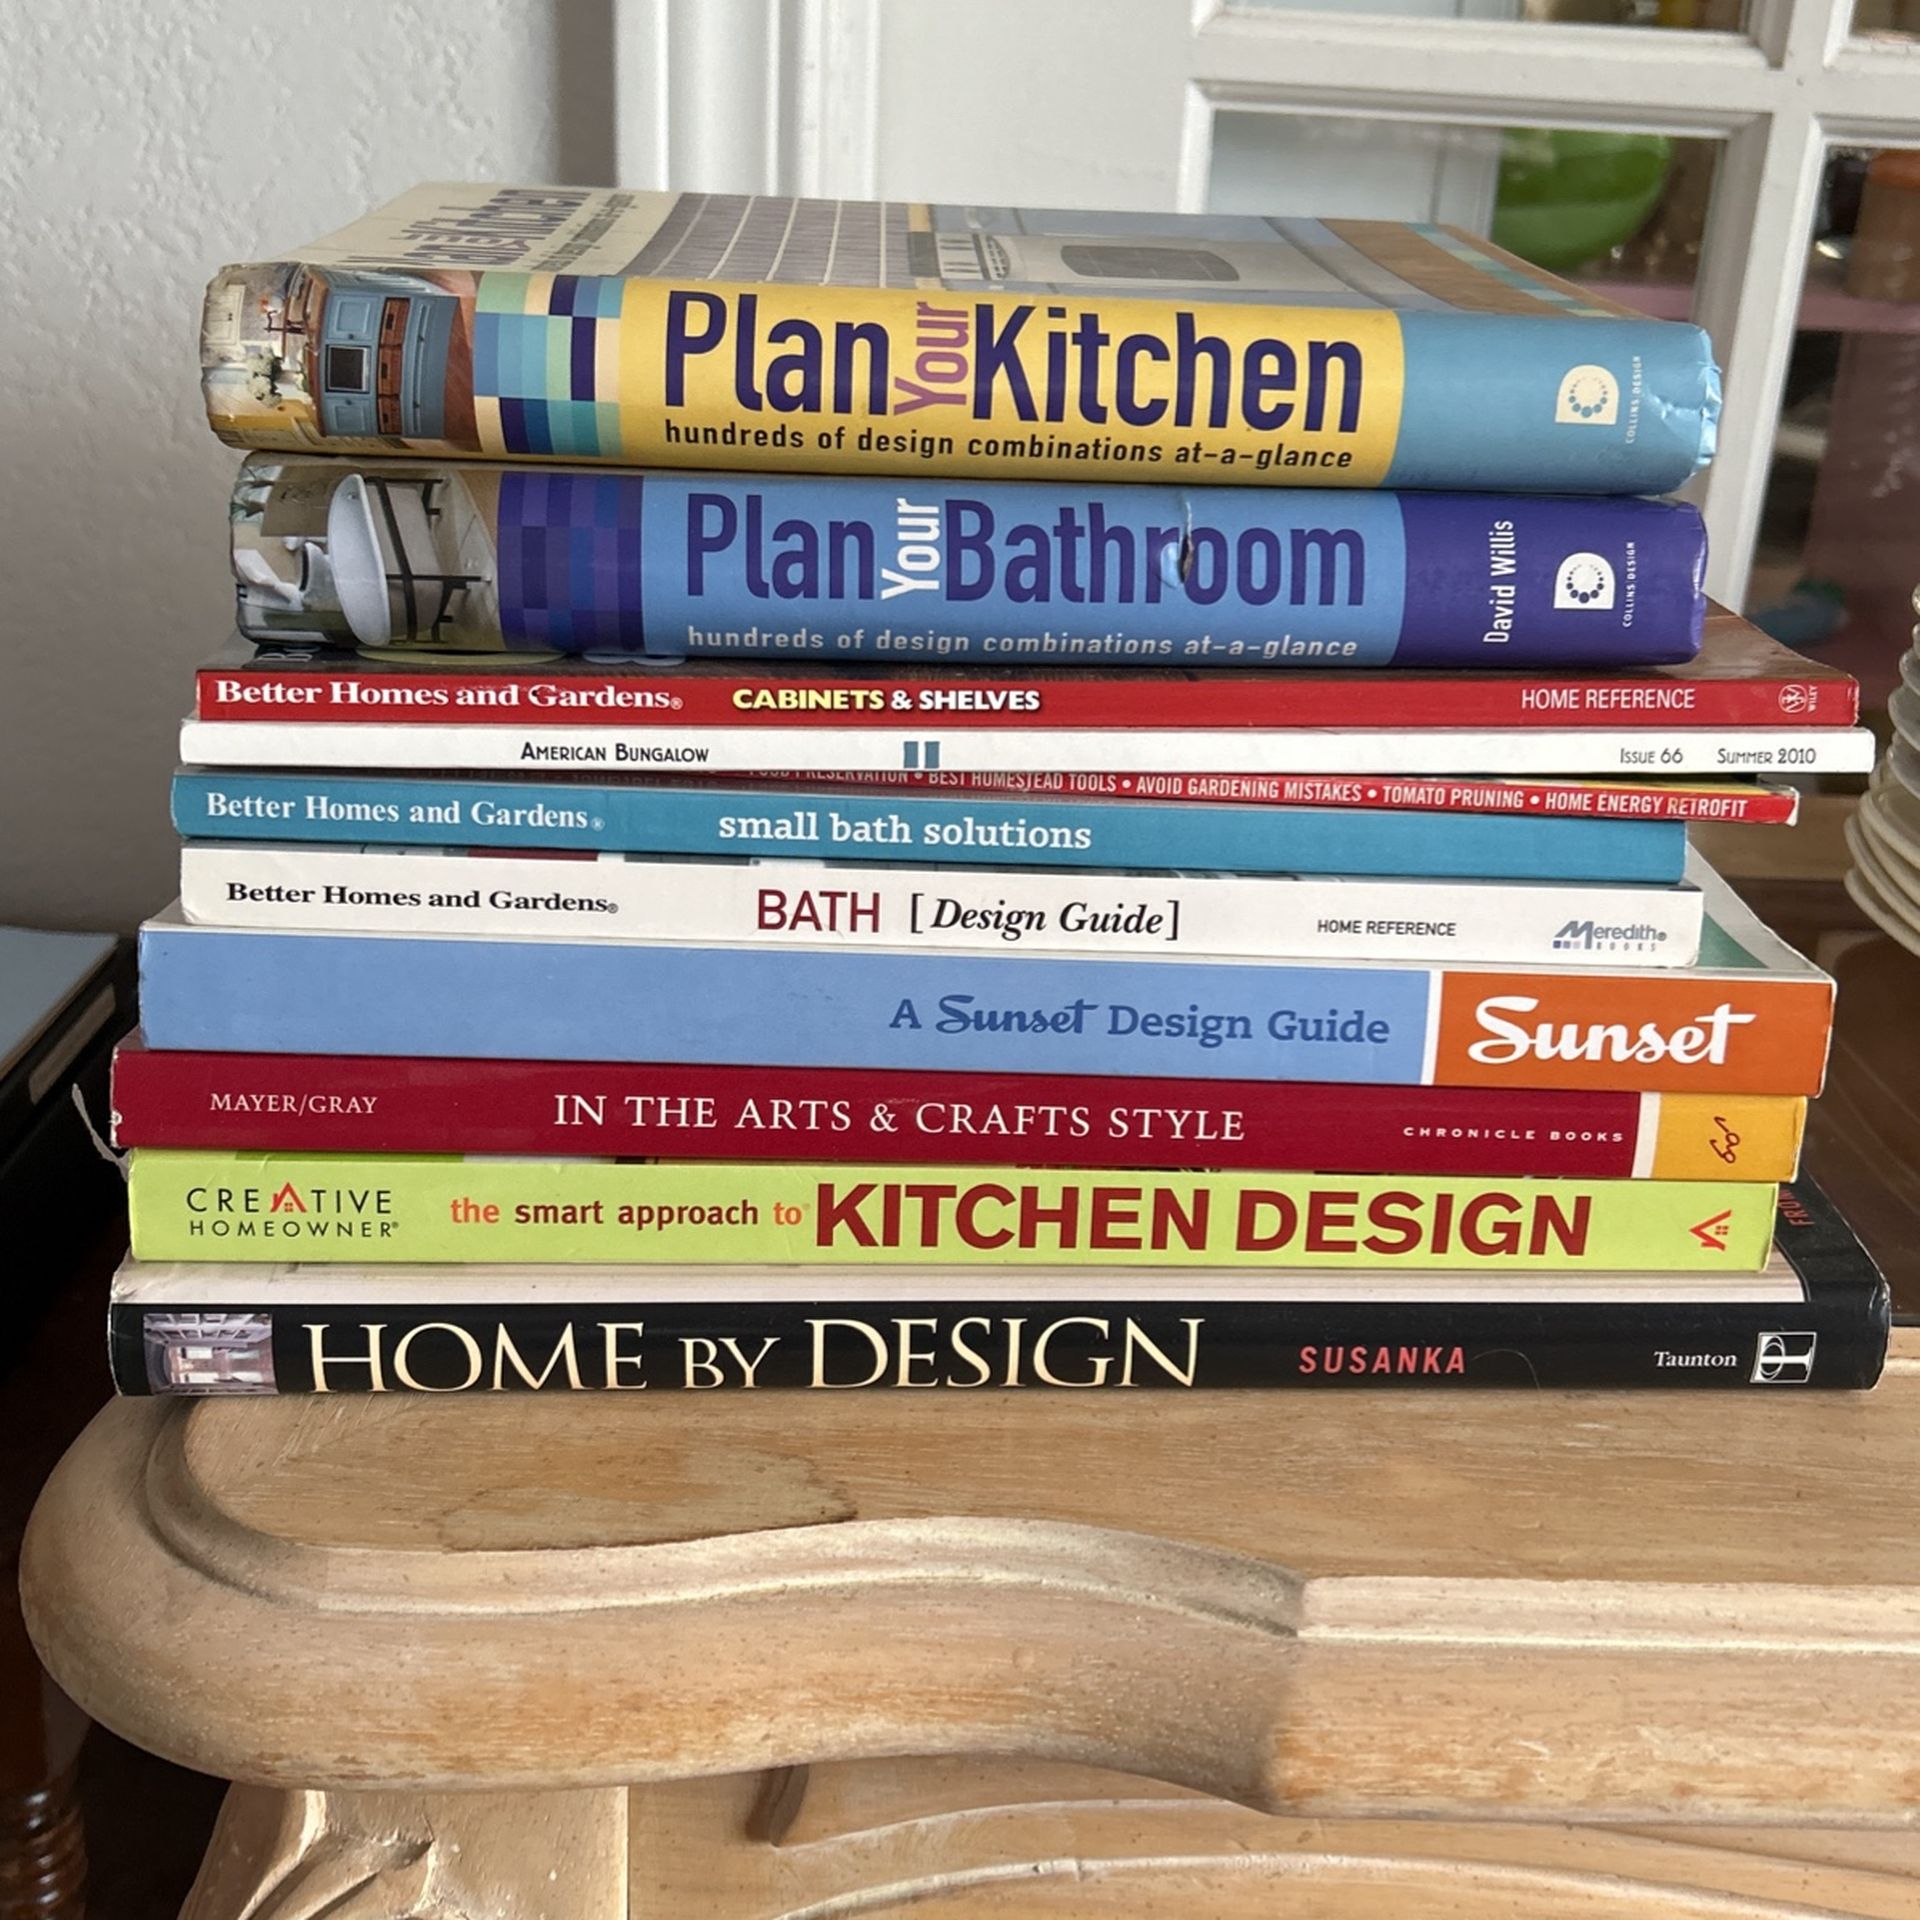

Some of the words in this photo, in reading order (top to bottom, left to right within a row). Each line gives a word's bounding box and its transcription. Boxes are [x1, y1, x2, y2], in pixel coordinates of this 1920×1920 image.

[664, 290, 889, 416] Plan
[893, 301, 969, 416] Your
[972, 303, 1363, 432] Kitchen
[1631, 355, 1642, 396] DESIGN
[1625, 398, 1640, 444] COLLINS
[665, 419, 804, 450] hundreds
[817, 427, 846, 450] of
[857, 429, 954, 458] design
[967, 435, 1162, 463] combinations
[1175, 441, 1353, 470] at-a-glance
[687, 493, 875, 600] Plan
[881, 498, 940, 600] Your
[945, 499, 1366, 606] Bathroom
[1488, 520, 1517, 577] Willis
[1626, 541, 1637, 580] DESIGN
[1483, 581, 1516, 644] David
[1622, 584, 1637, 628] COLLINS
[688, 626, 823, 650] hundreds
[837, 629, 865, 650] of
[875, 629, 969, 655] design
[983, 633, 1173, 656] combinations
[1184, 636, 1358, 659] at-a-glance
[215, 679, 323, 706] Better
[329, 680, 449, 707] Homes
[456, 683, 519, 708] and
[732, 688, 885, 712] CABINETS
[891, 689, 913, 712] &
[918, 689, 1041, 712] SHELVES
[1521, 688, 1580, 710] HOME
[1585, 688, 1696, 710] REFERENCE
[1660, 748, 1684, 765] 66
[1778, 748, 1817, 765] 2010
[206, 792, 296, 820] Better
[305, 794, 400, 825] Homes
[409, 799, 461, 826] and
[928, 772, 966, 787] BEST
[972, 773, 1063, 791] HOMESTEAD
[1068, 774, 1117, 793] TOOLS
[1136, 776, 1183, 795] AVOID
[1187, 778, 1279, 799] GARDENING
[1284, 782, 1363, 802] MISTAKES
[1382, 785, 1446, 805] TOMATO
[1450, 788, 1524, 808] PRUNING
[1545, 793, 1592, 812] HOME
[1598, 794, 1664, 815] ENERGY
[1667, 797, 1748, 818] RETROFIT
[718, 812, 819, 841] small
[829, 813, 913, 844] bath
[923, 818, 1092, 850] solutions
[227, 883, 316, 905] Better
[322, 885, 422, 907] Homes
[428, 888, 482, 910] and
[757, 889, 881, 933] BATH
[1058, 900, 1180, 942] Guide]
[1317, 919, 1363, 934] HOME
[1366, 920, 1457, 937] REFERENCE
[889, 999, 922, 1029] A
[935, 994, 1099, 1035] Sunset
[1107, 1004, 1253, 1048] Design
[1267, 1009, 1391, 1045] Guide
[1467, 995, 1757, 1067] Sunset
[210, 1092, 378, 1116] MAYER/GRAY
[554, 1095, 607, 1127] IN
[623, 1096, 718, 1129] THE
[734, 1098, 852, 1132] ARTS
[869, 1101, 899, 1132] &
[915, 1101, 1090, 1138] CRAFTS
[1108, 1105, 1246, 1142] STYLE
[1402, 1126, 1536, 1141] CHRONICLE
[1549, 1131, 1624, 1143] BOOKS
[186, 1182, 392, 1215] CREATIVE
[451, 1196, 501, 1225] the
[514, 1199, 604, 1226] smart
[617, 1198, 760, 1232] approach
[772, 1201, 803, 1226] to
[815, 1181, 1211, 1252] KITCHEN
[1235, 1189, 1592, 1257] DESIGN
[302, 1319, 646, 1395] HOME
[679, 1337, 782, 1390] BY
[805, 1316, 1206, 1390] DESIGN
[1298, 1345, 1467, 1375] SUSANKA
[1654, 1351, 1738, 1368] Taunton
